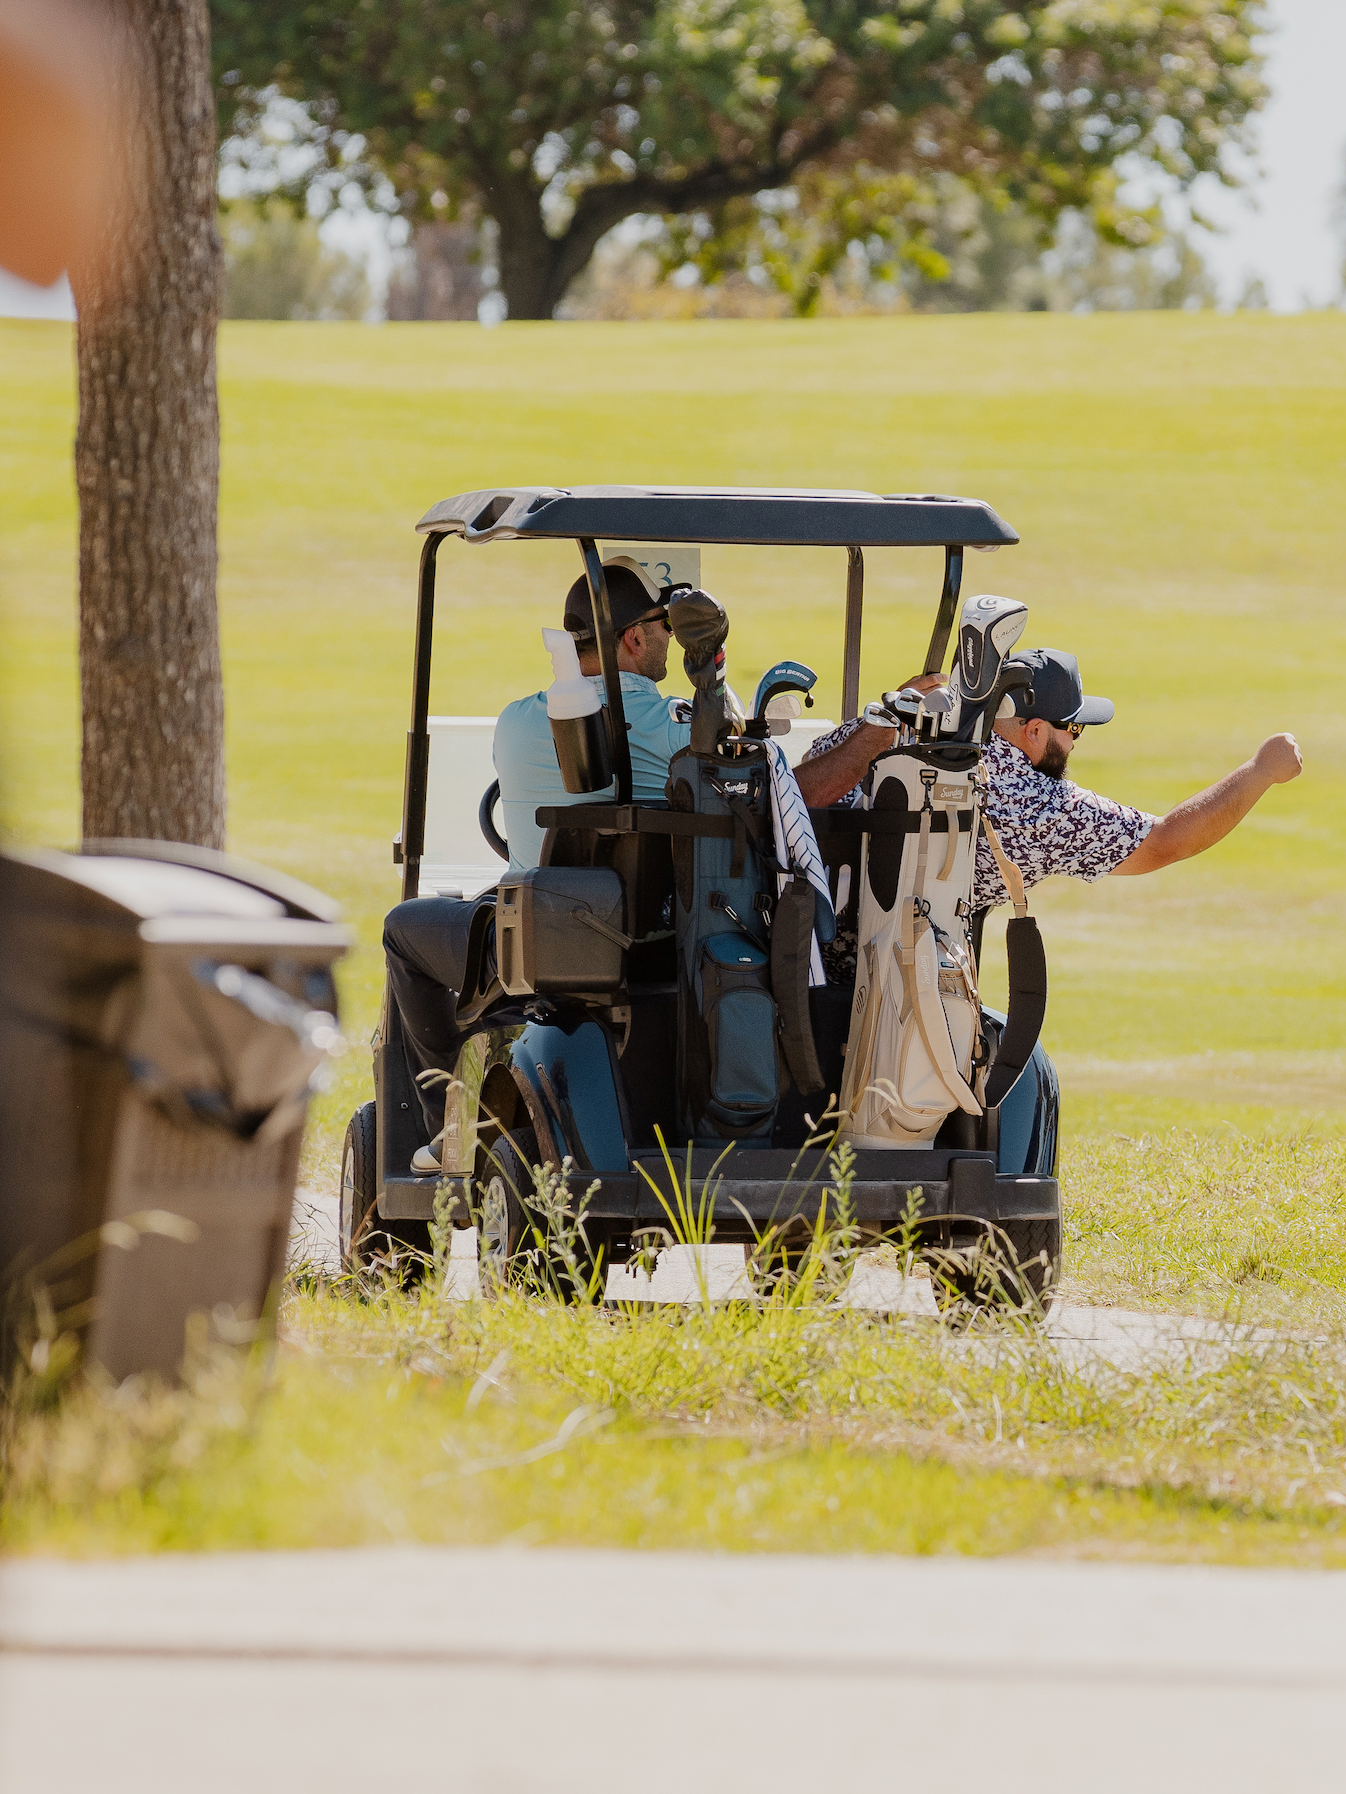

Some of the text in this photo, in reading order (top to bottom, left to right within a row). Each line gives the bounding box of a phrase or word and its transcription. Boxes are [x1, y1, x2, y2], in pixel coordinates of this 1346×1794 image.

[638, 562, 673, 586] 3
[724, 781, 748, 794] Sunday
[920, 954, 931, 985] Sunday
